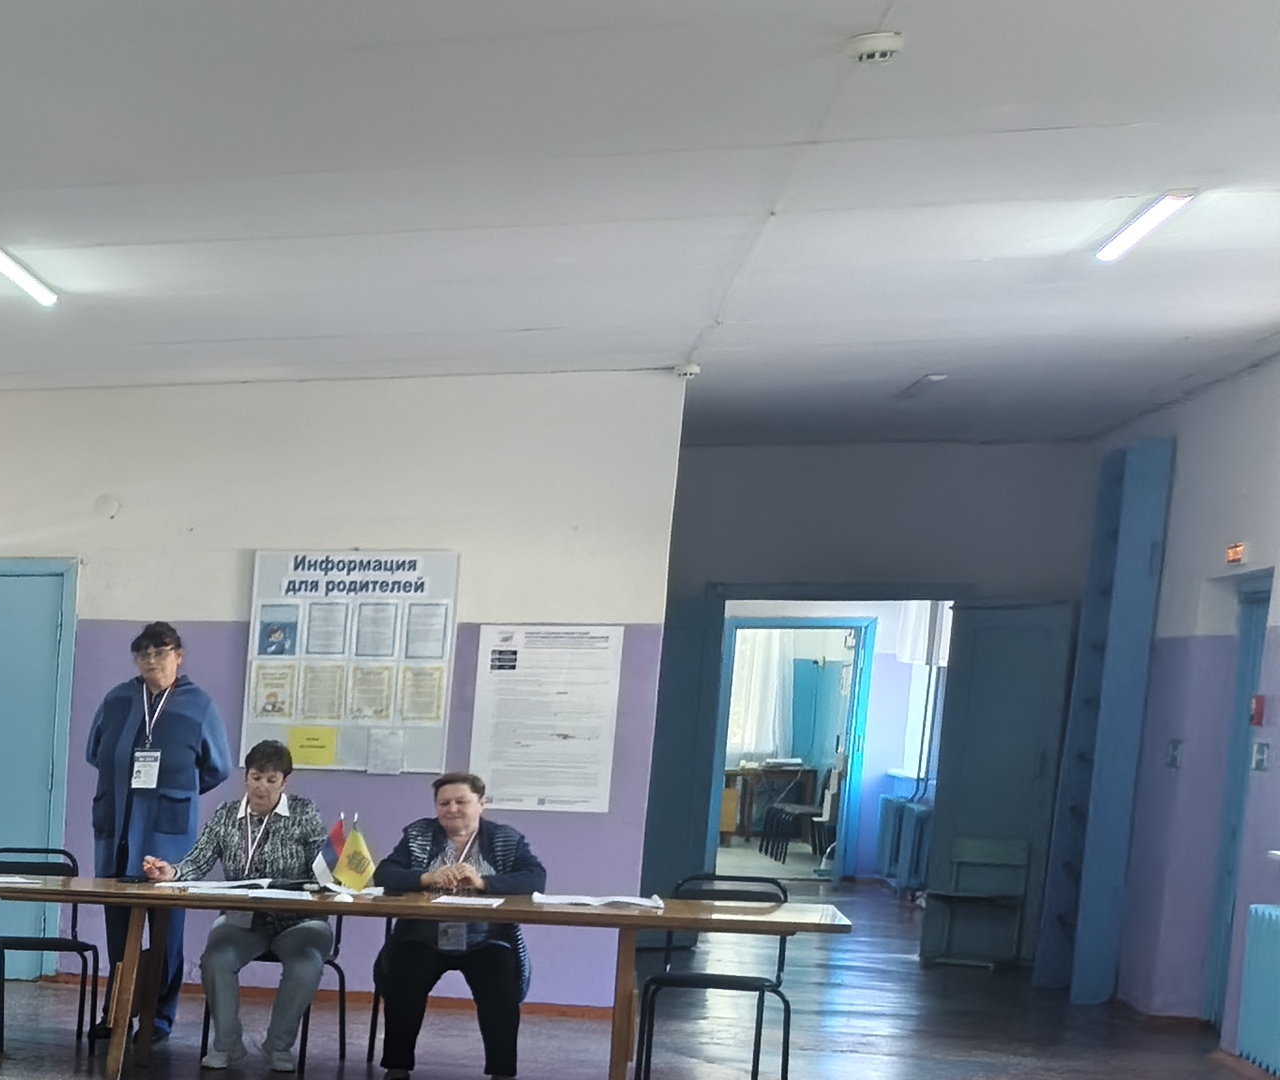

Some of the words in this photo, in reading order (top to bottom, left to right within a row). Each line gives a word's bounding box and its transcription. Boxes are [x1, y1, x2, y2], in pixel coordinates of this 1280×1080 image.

[293, 555, 418, 576] Информация
[285, 579, 319, 595] для
[325, 576, 425, 596] родителей
